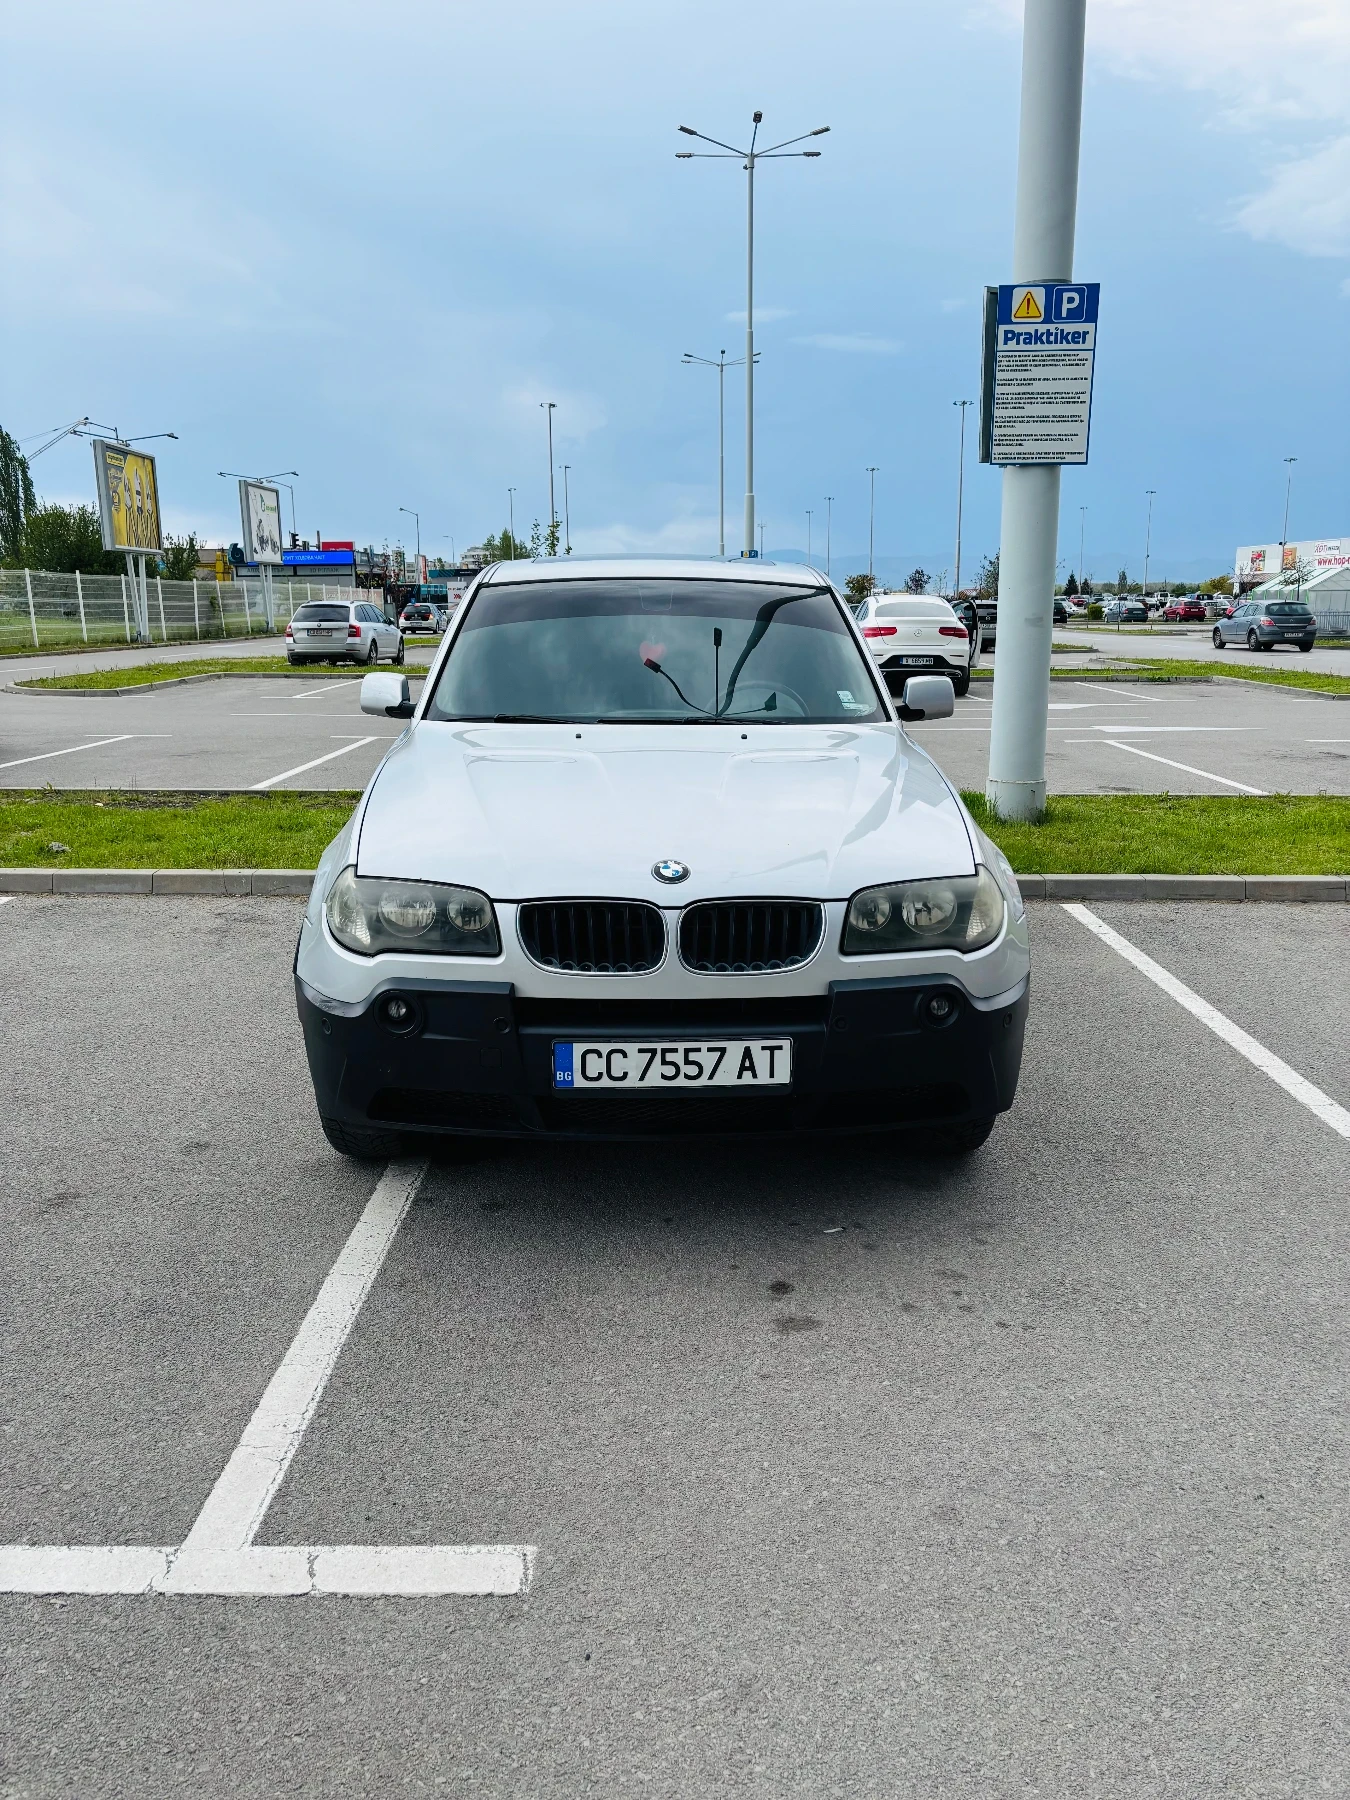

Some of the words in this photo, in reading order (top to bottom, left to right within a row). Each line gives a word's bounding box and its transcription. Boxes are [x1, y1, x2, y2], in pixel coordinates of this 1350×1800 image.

[1061, 291, 1080, 318] P
[1003, 326, 1089, 346] Praktiker
[580, 1048, 629, 1082] CC
[637, 1046, 727, 1082] 7557
[736, 1044, 784, 1080] AT
[556, 1071, 572, 1081] BG
